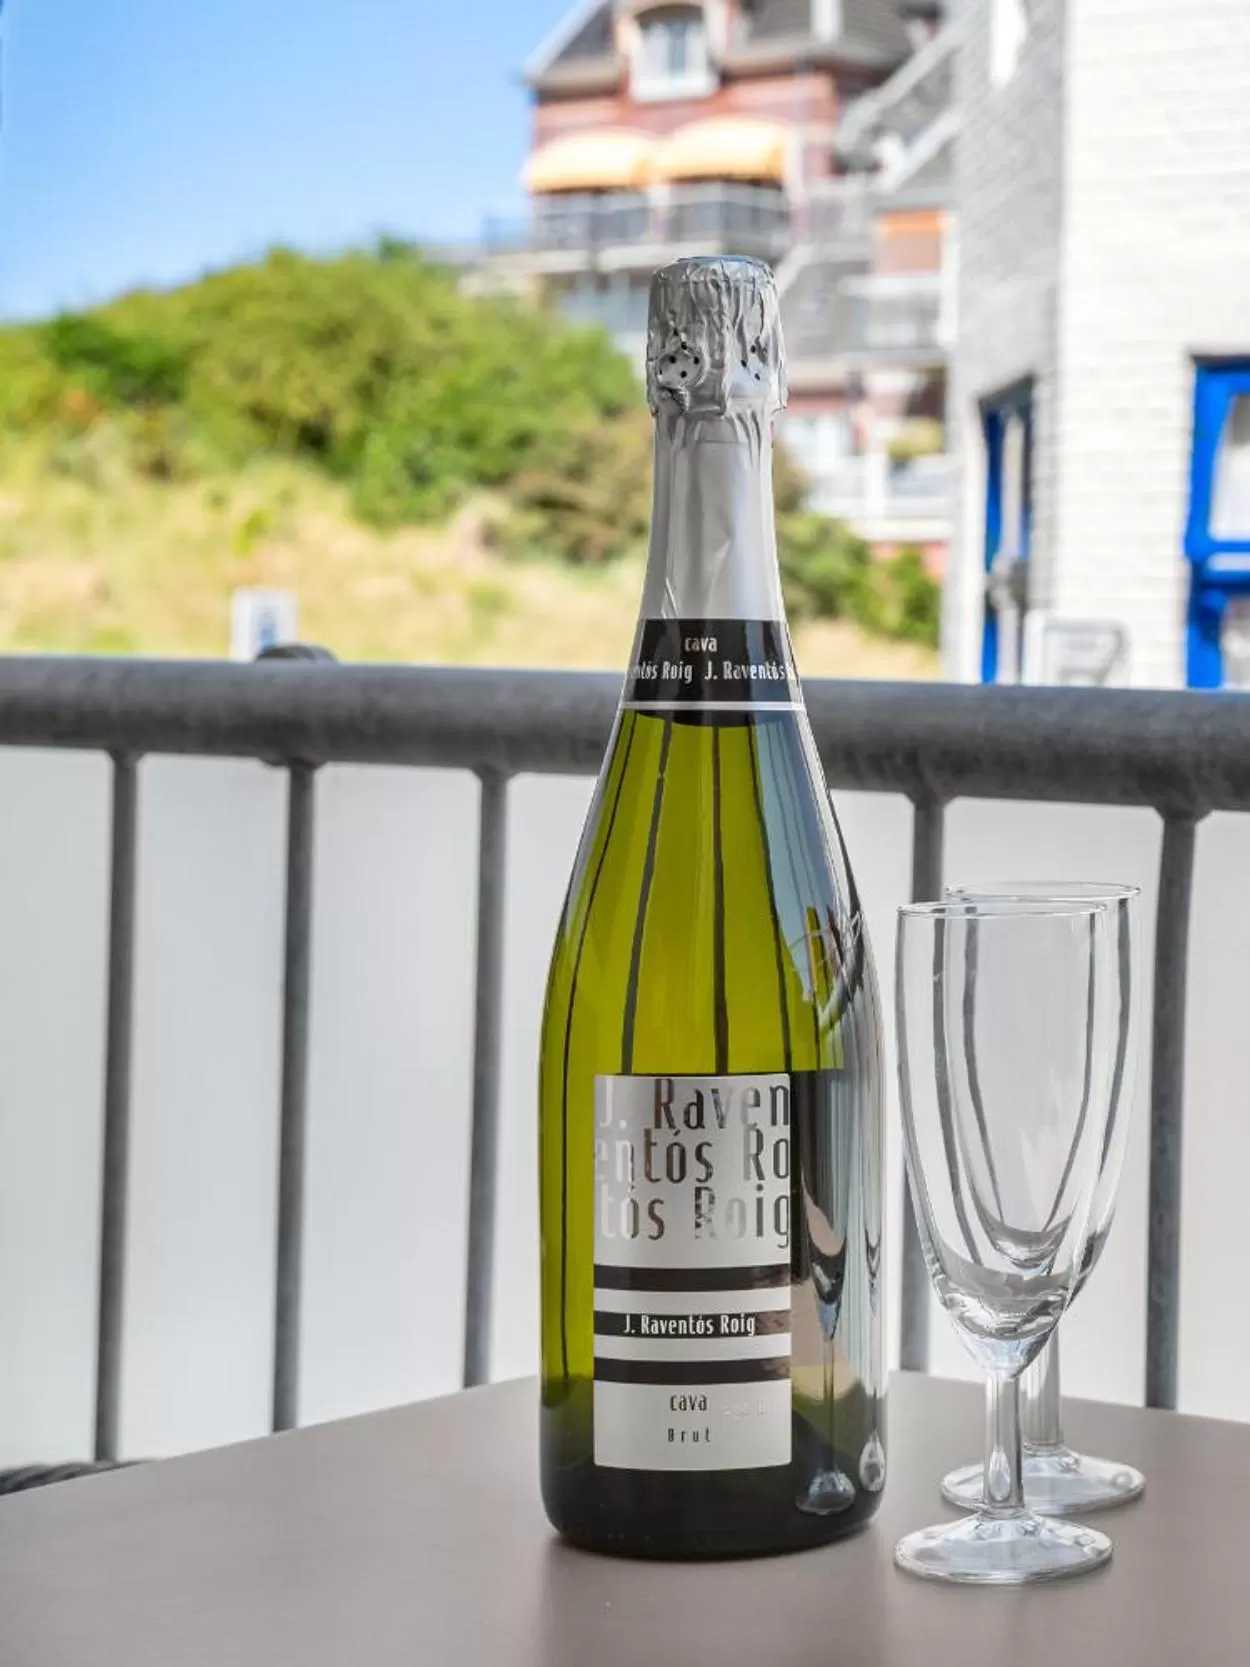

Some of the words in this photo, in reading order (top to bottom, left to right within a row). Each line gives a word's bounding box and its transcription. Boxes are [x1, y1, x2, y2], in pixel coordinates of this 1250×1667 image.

[684, 636, 718, 653] cava
[662, 660, 693, 685] Roig
[704, 661, 718, 680] J.
[600, 1078, 627, 1129] J.
[654, 1078, 789, 1130] Raven
[743, 1123, 789, 1181] Ro
[694, 1183, 789, 1249] Roig
[624, 1314, 635, 1334] J.
[641, 1314, 714, 1335] Raventós
[720, 1313, 756, 1337] Roig
[669, 1394, 708, 1413] cava
[667, 1427, 711, 1444] Brut
